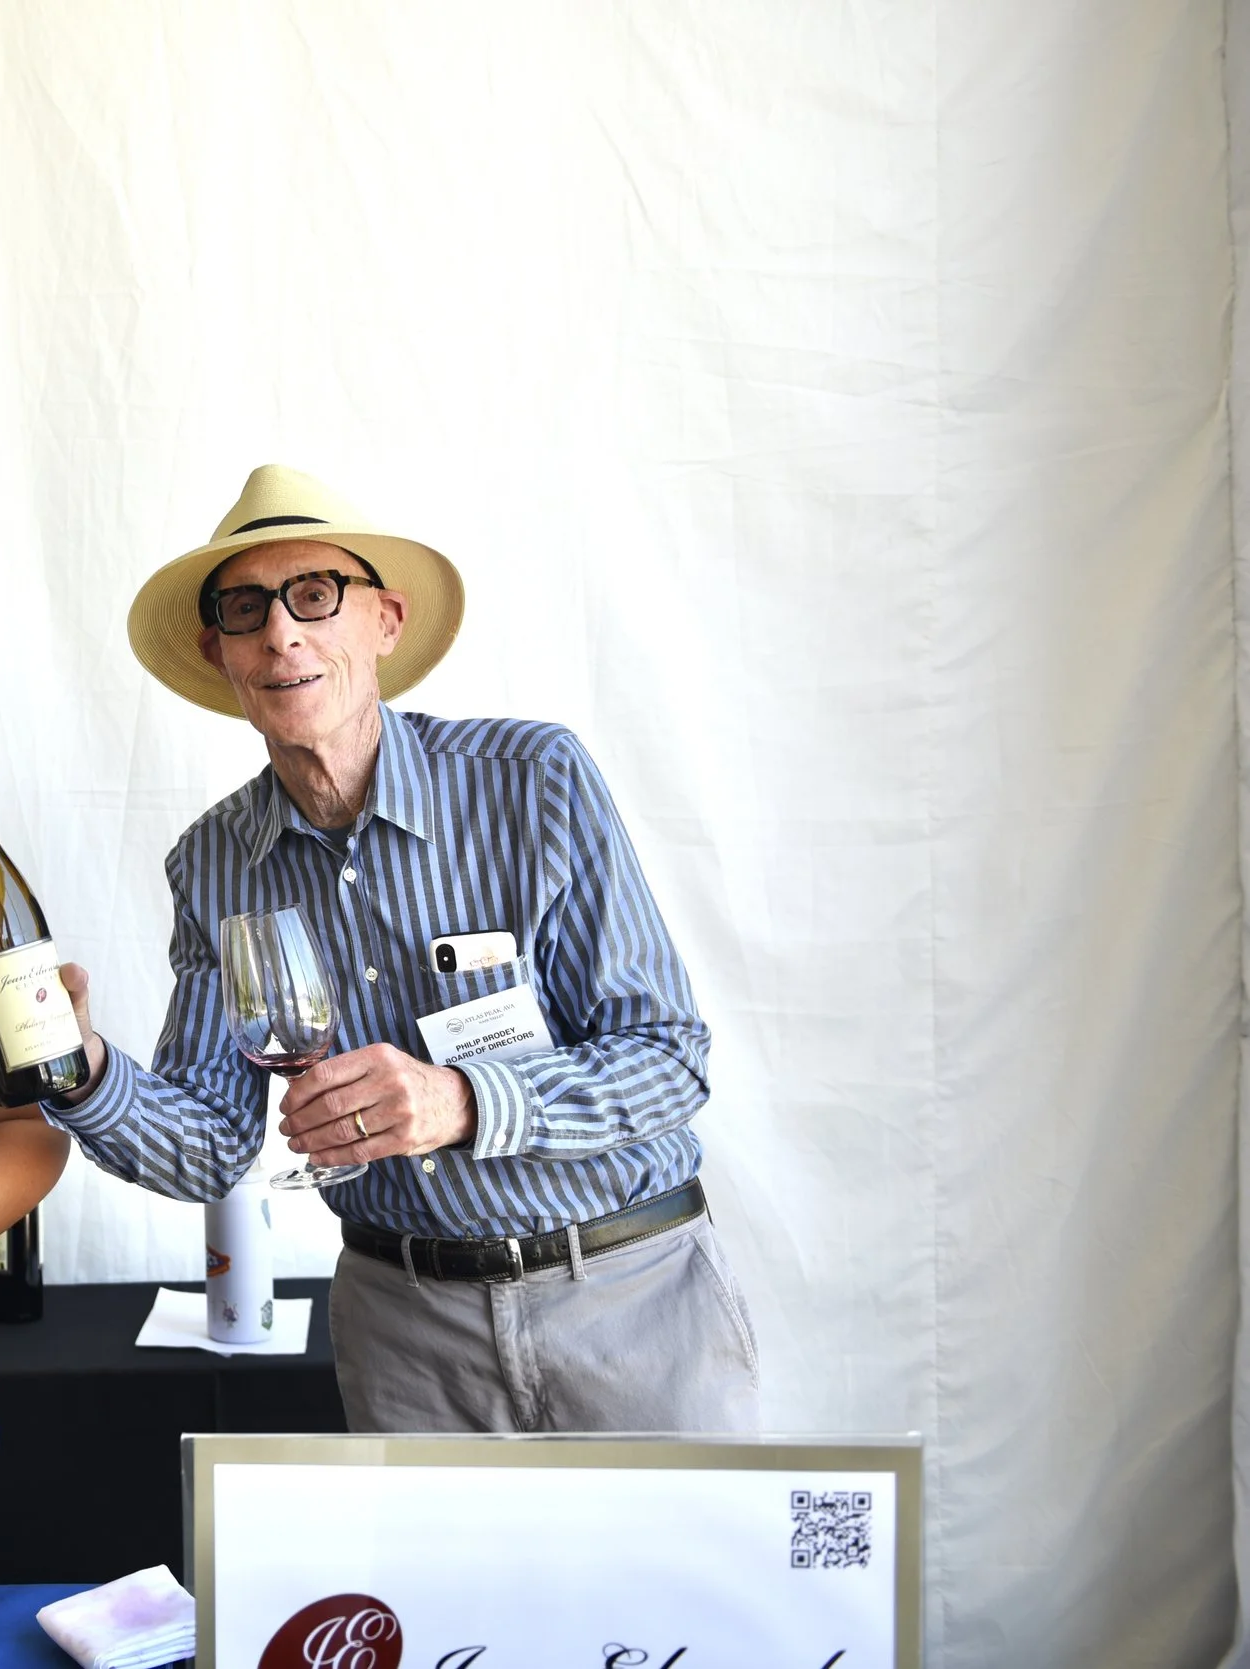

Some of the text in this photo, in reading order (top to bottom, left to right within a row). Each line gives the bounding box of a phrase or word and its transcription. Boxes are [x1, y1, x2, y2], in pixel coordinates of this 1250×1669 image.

[464, 1003, 516, 1024] ATLAS PEAK AVA
[445, 1030, 535, 1065] BOARD OF DIRECTORS
[455, 1026, 516, 1052] PHILIP BRODEY
